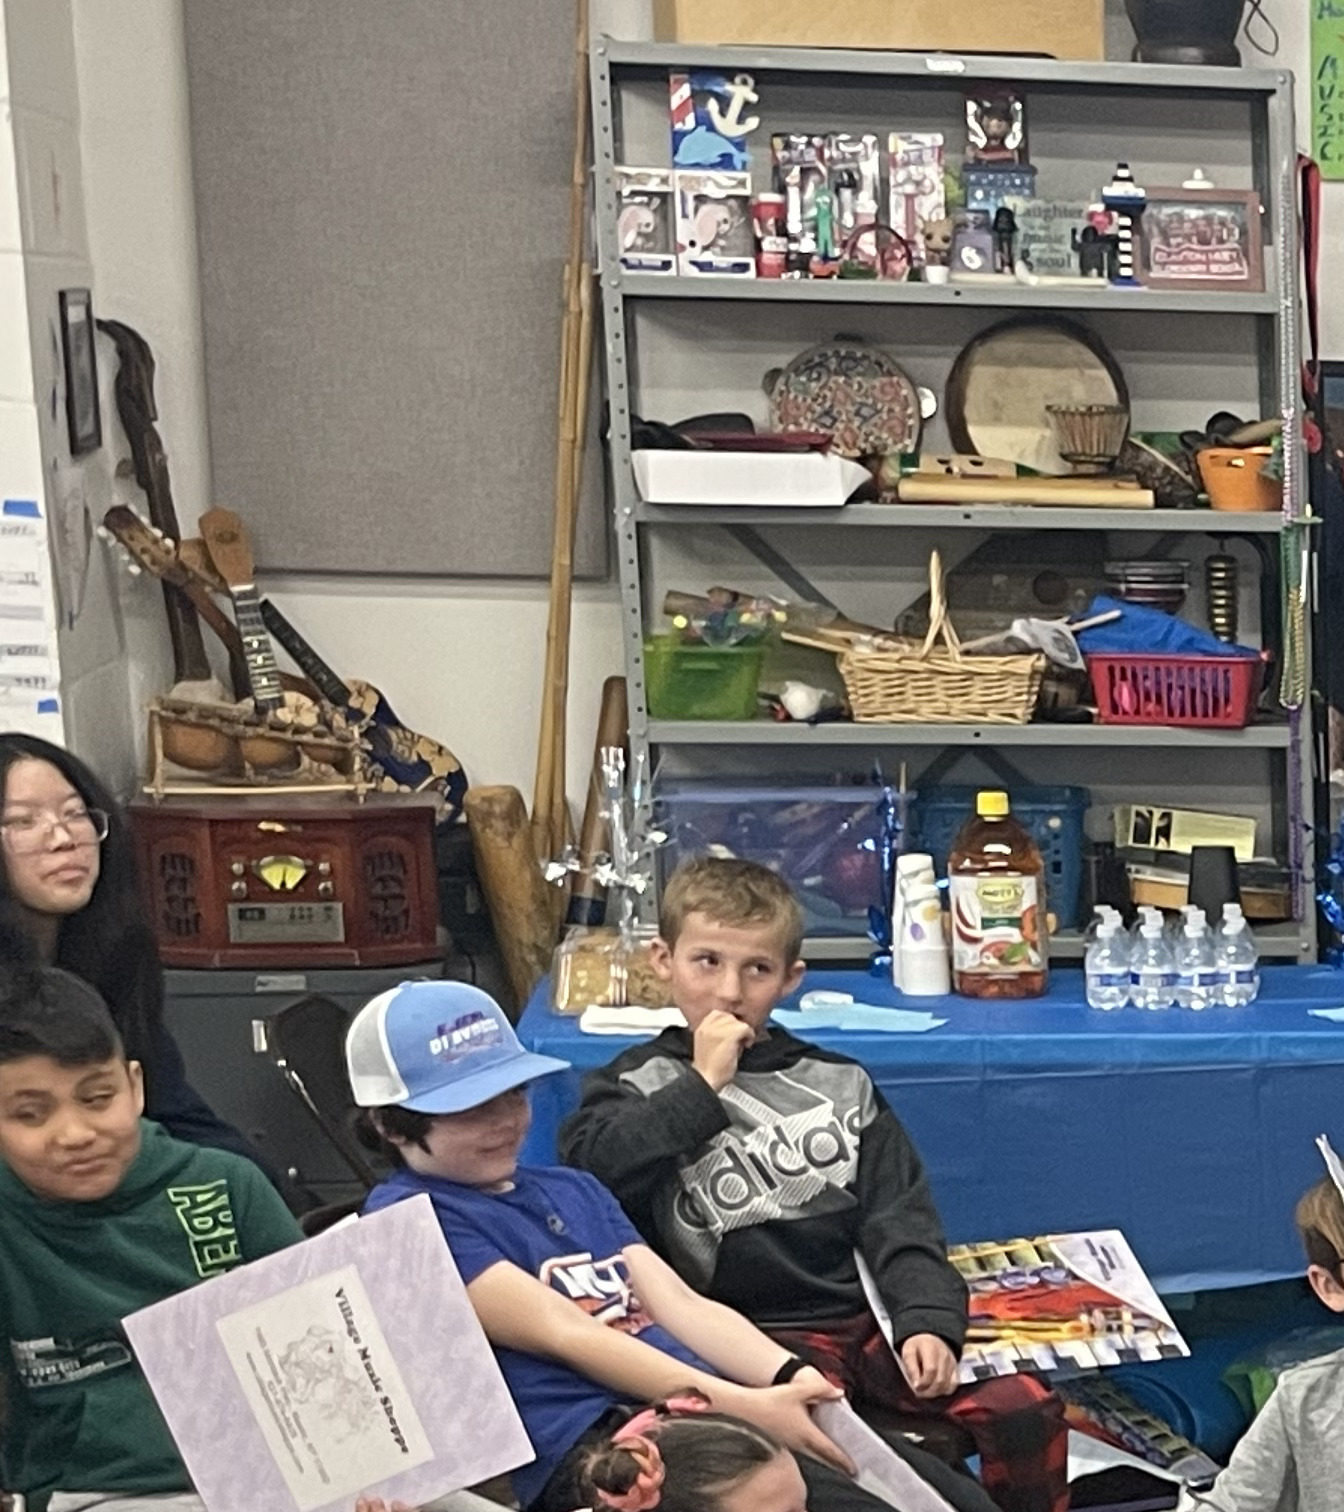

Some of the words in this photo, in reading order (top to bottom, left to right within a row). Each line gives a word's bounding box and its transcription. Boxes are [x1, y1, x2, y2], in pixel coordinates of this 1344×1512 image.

[1035, 253, 1072, 269] soul
[335, 1286, 361, 1344] Village
[358, 1346, 382, 1392] Music
[380, 1395, 409, 1453] Shoppe
